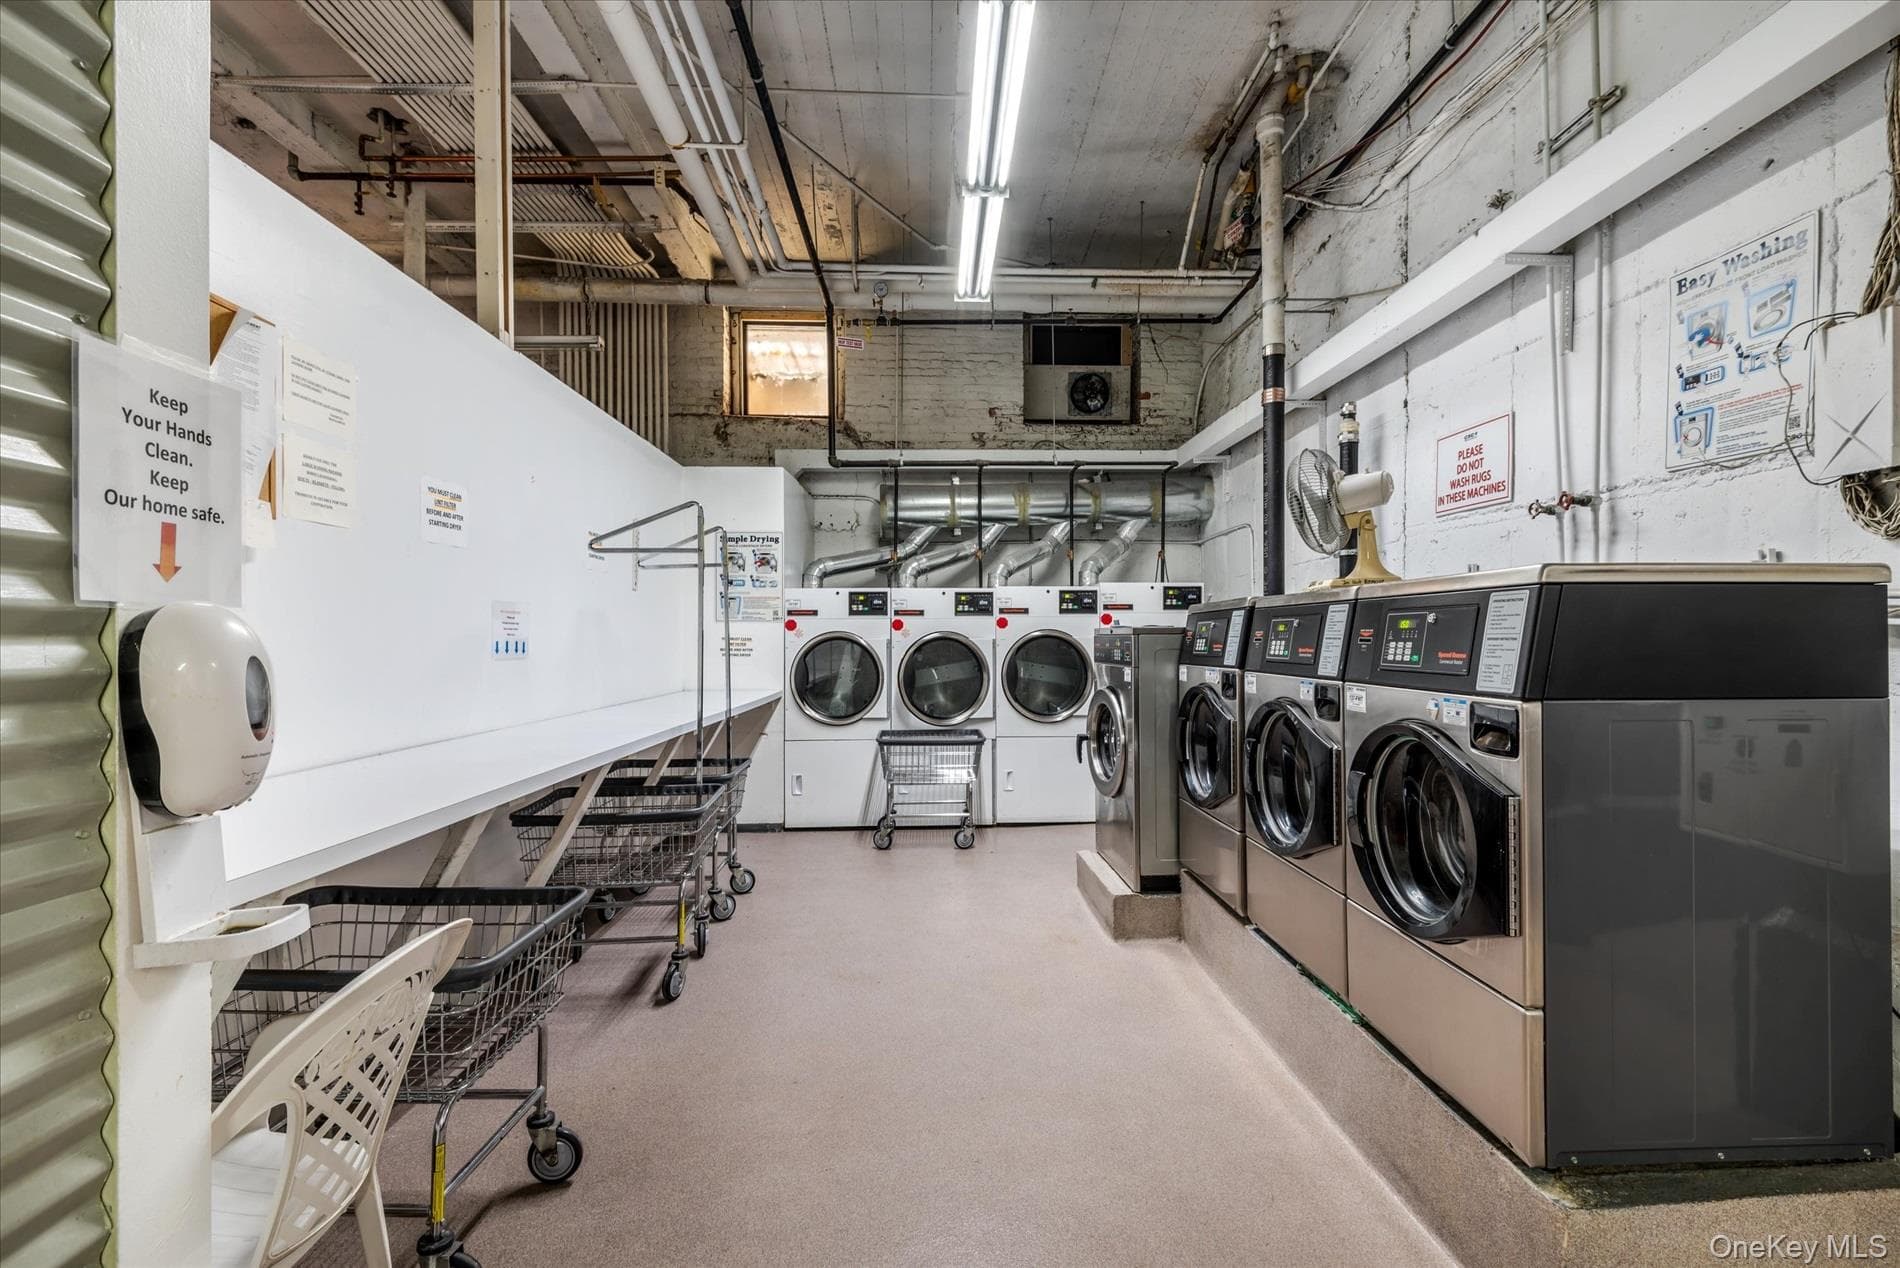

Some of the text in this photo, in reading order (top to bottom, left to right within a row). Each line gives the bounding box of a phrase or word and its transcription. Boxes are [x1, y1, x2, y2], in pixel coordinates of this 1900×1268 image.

[1676, 229, 1808, 296] Easy Washing
[1757, 262, 1776, 274] LOAD
[150, 388, 188, 416] Keep
[122, 407, 212, 446] Your Hands
[145, 442, 193, 467] Clean.
[1458, 444, 1483, 460] PLEASE
[1457, 458, 1484, 475] DO NOT
[150, 469, 189, 494] Keep
[1450, 470, 1491, 490] WASH RUGS
[437, 489, 449, 497] MUST
[1438, 480, 1506, 506] IN THESE MACHINES
[104, 489, 225, 524] Our home safe.
[426, 508, 463, 521] BEFORE AND AFTER
[429, 519, 449, 528] STARTING
[750, 535, 779, 544] Drying
